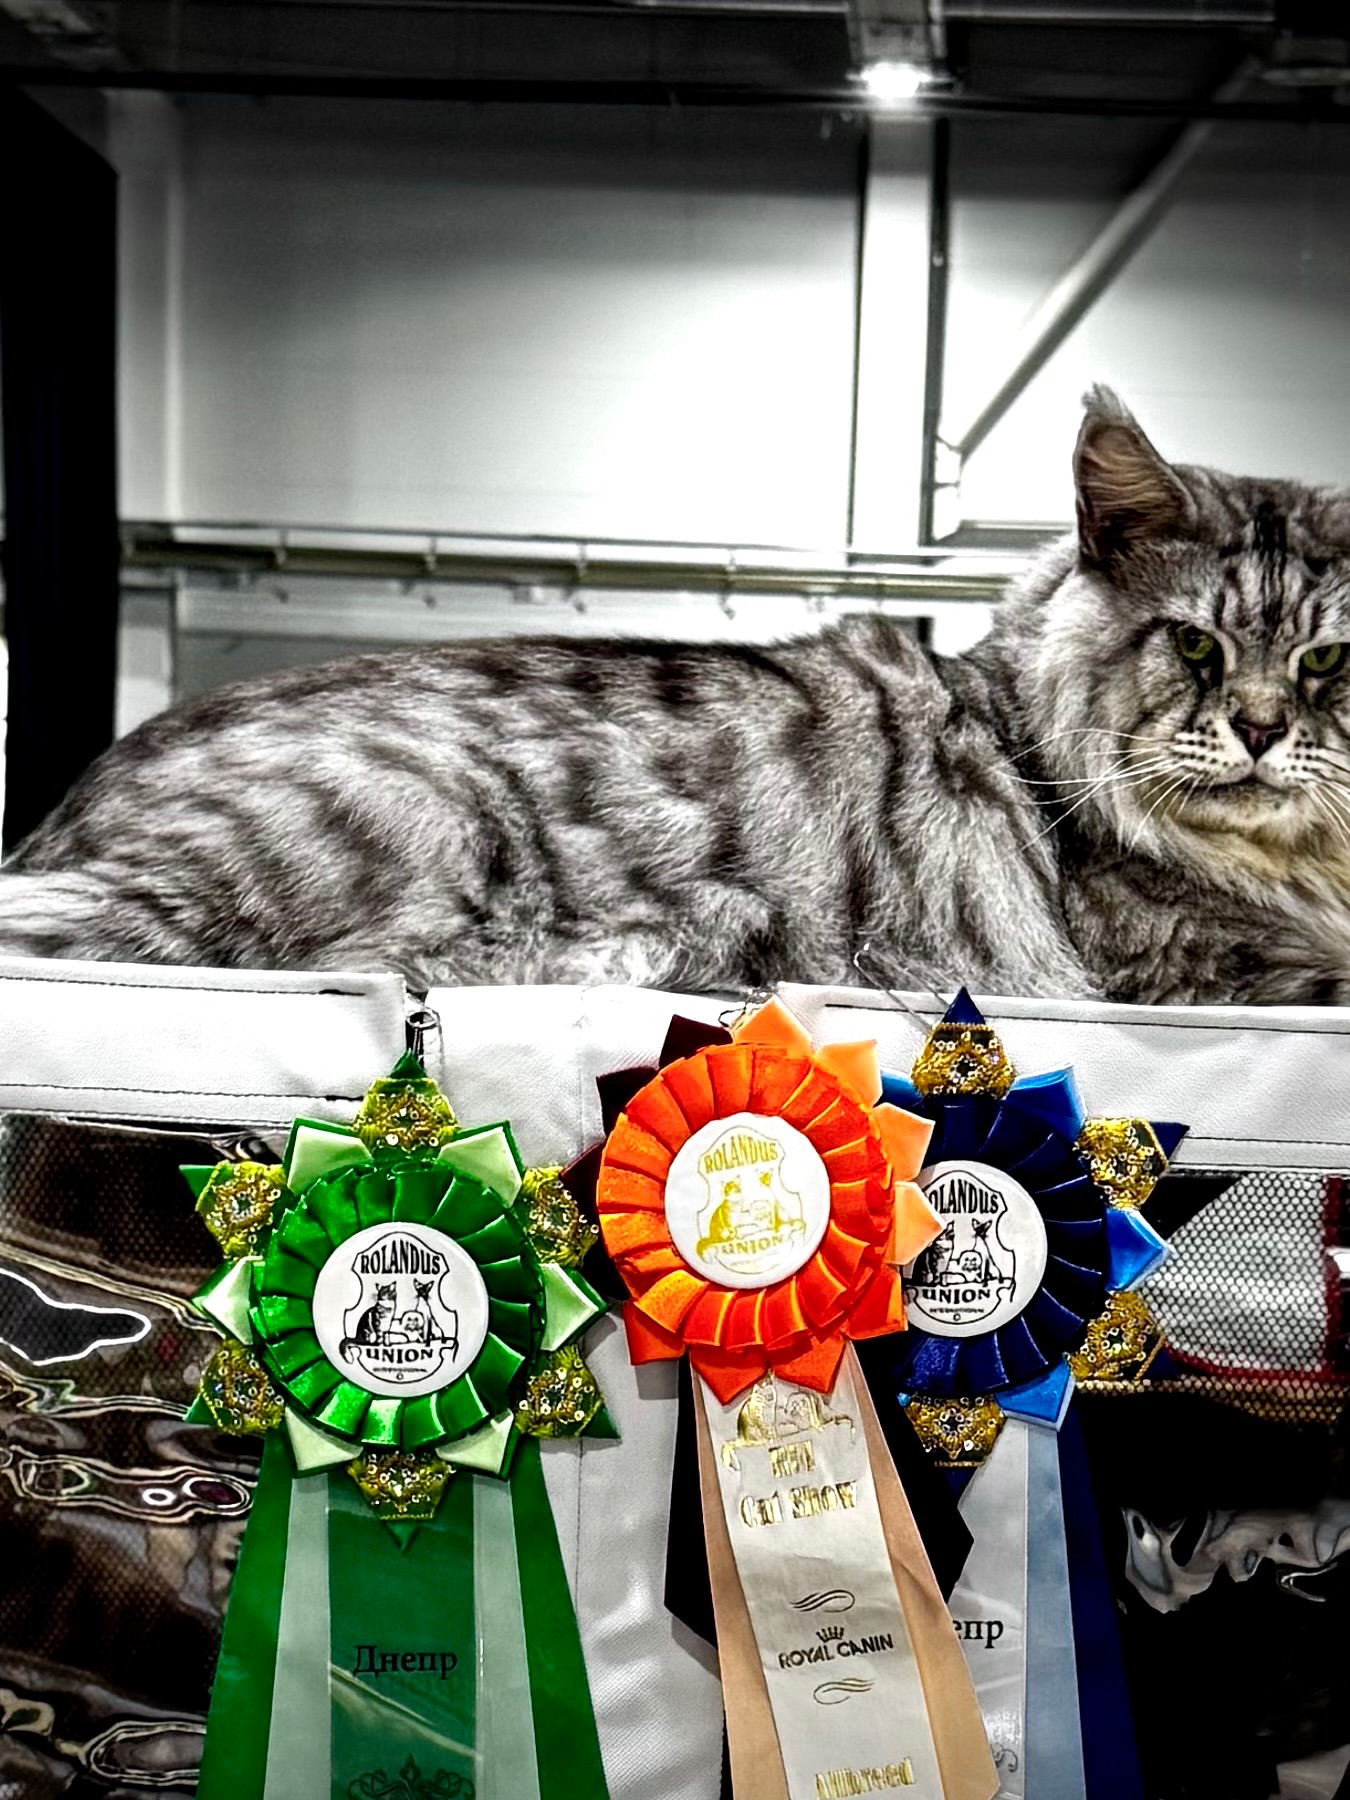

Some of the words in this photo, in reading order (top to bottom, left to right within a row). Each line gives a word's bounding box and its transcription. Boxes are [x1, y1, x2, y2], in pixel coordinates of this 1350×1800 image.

[704, 1134, 779, 1174] ROLANDUS
[928, 1178, 999, 1214] OLANDUS
[360, 1239, 441, 1275] ROLANDUS
[721, 1235, 784, 1255] UNION
[922, 1288, 991, 1304] UNION
[366, 1348, 434, 1364] UNION
[352, 1644, 458, 1680] Днепр
[778, 1644, 835, 1670] ROYAL
[836, 1633, 895, 1658] CANIN
